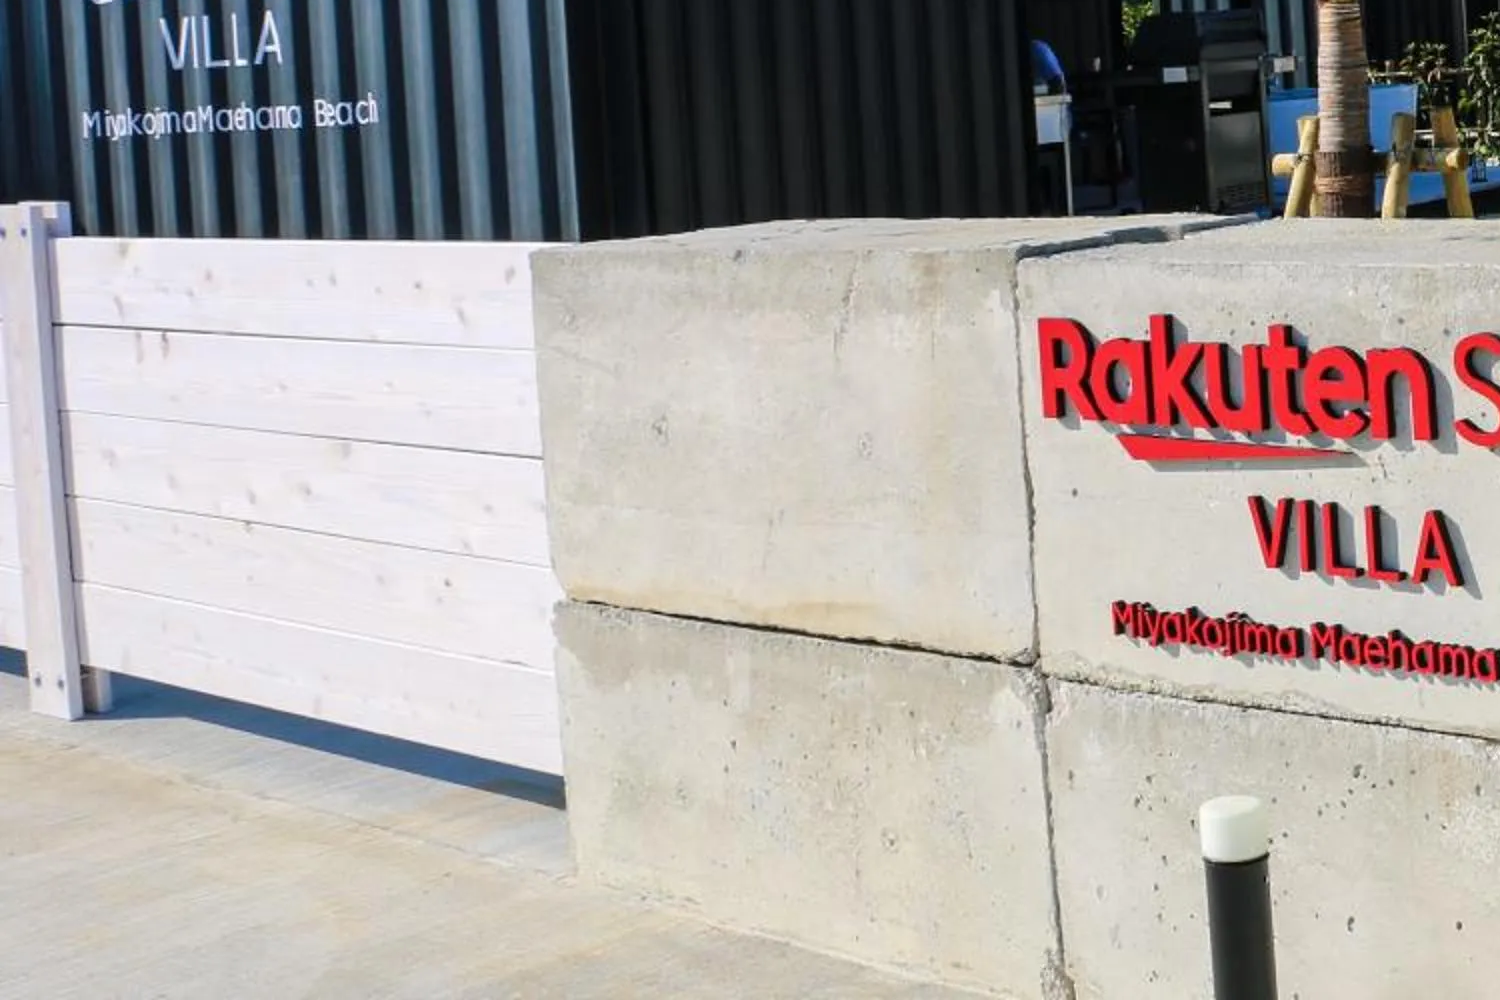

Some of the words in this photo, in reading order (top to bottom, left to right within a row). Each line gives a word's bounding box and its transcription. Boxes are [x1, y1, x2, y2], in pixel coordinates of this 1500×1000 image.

[159, 9, 283, 70] VILLA
[314, 92, 379, 128] Beach
[1038, 314, 1438, 443] Rakuten
[1247, 495, 1463, 588] VILLA
[1111, 600, 1300, 661] Miyakojima
[1310, 622, 1500, 683] Maehama
